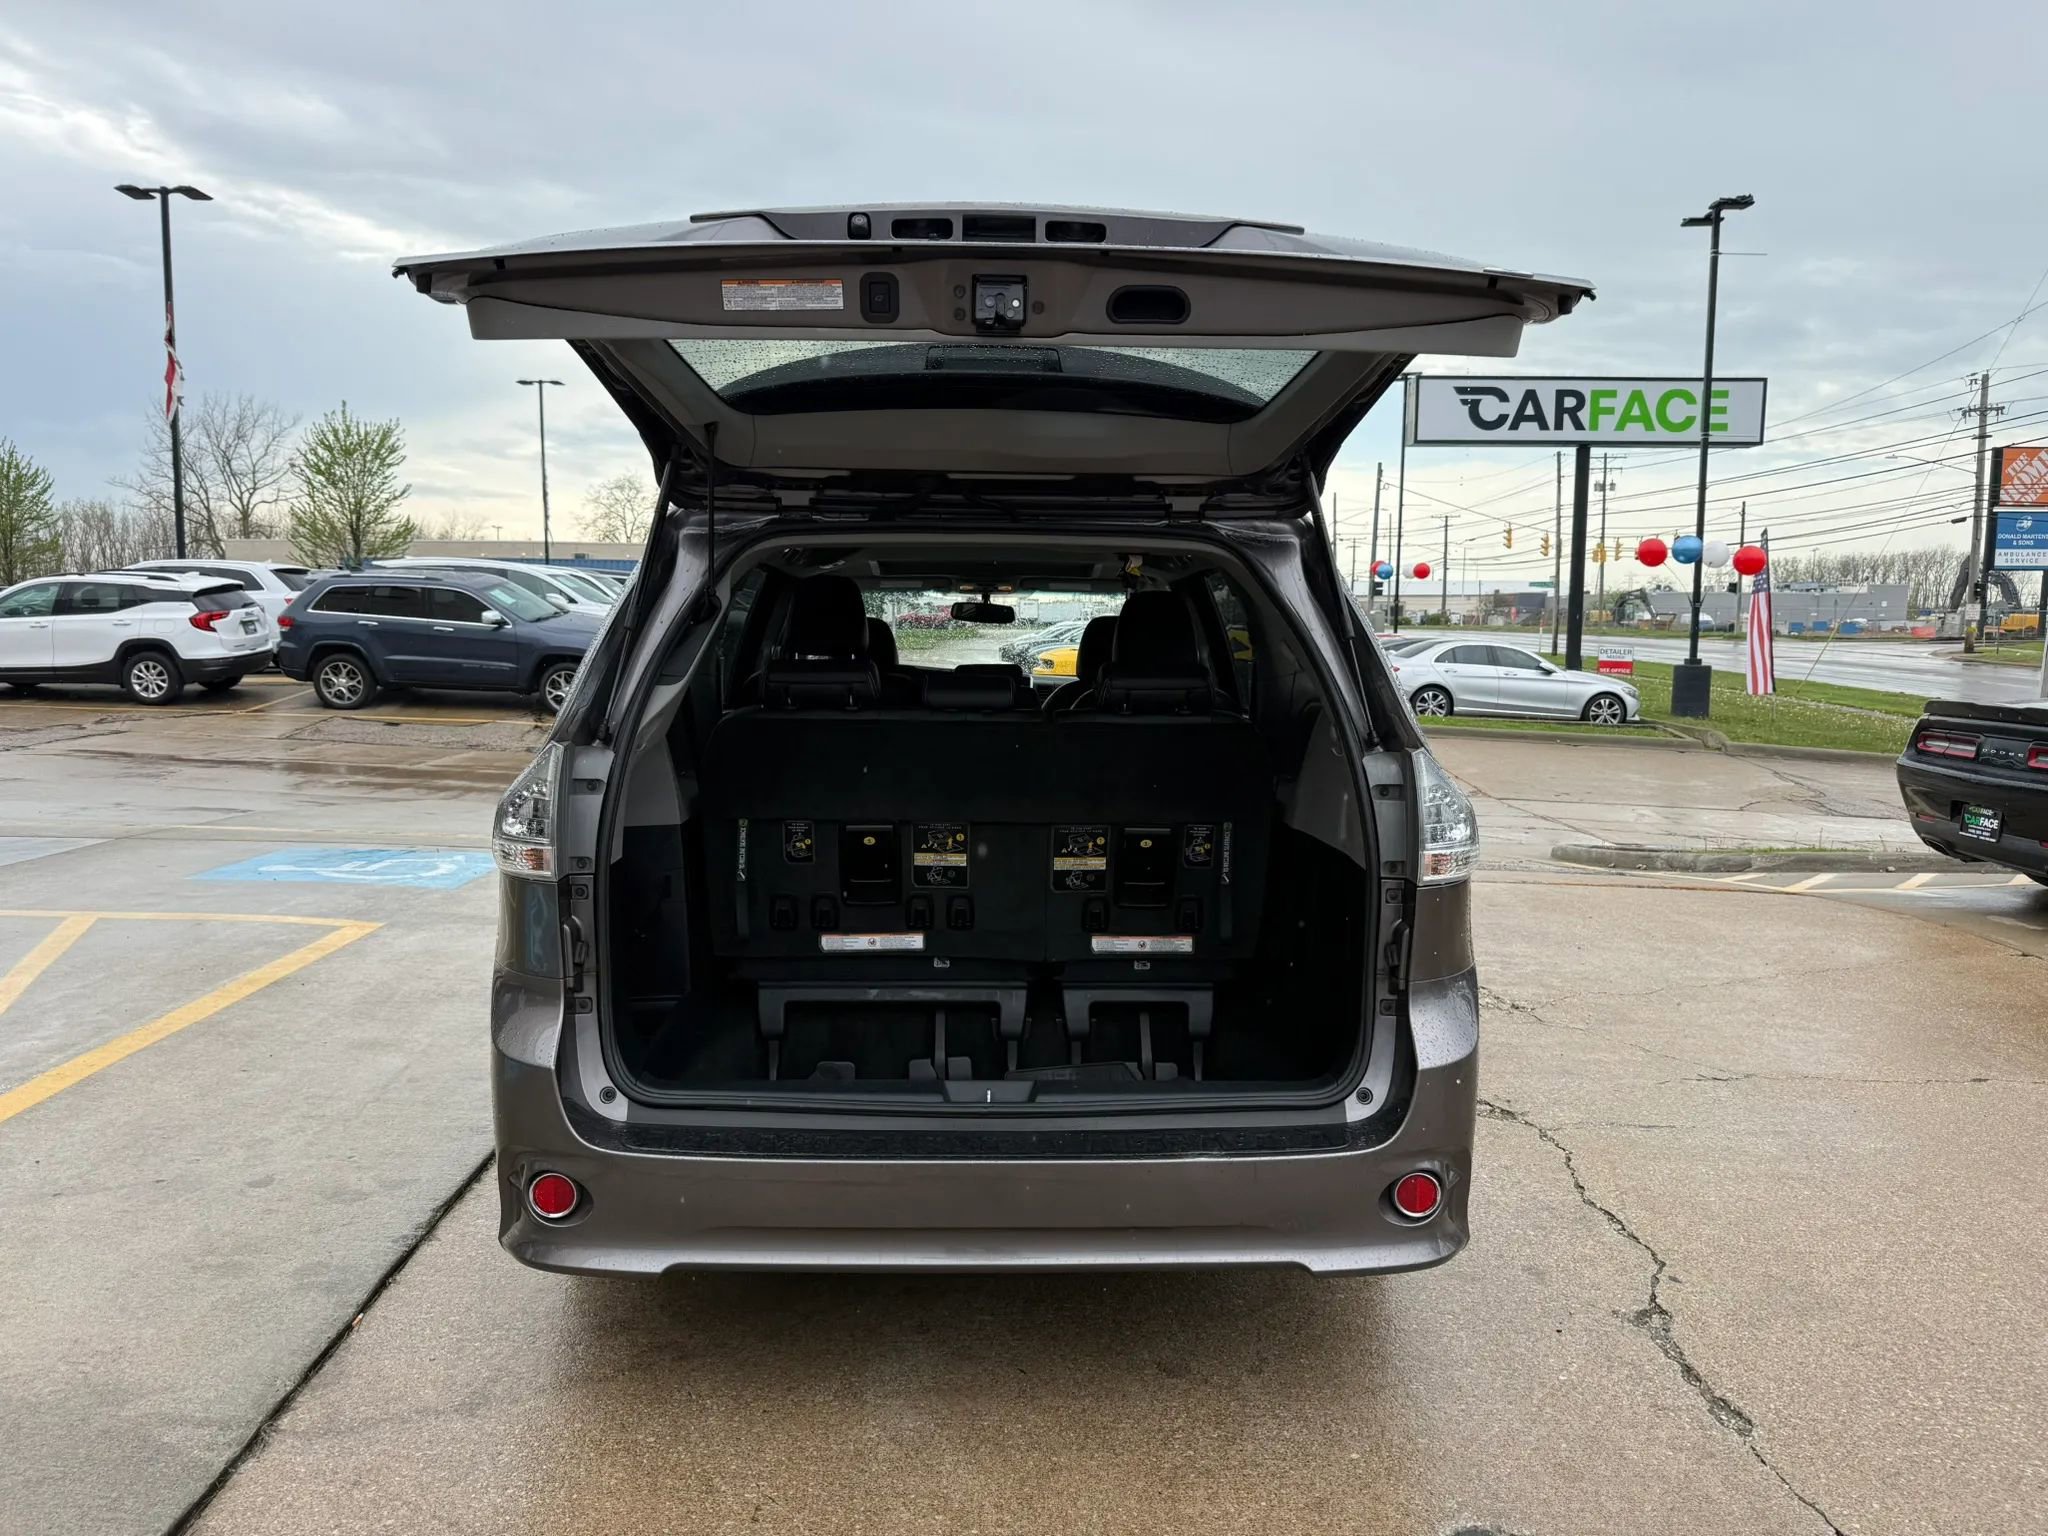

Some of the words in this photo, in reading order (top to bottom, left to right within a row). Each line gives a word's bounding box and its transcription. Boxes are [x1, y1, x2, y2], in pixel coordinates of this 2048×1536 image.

[1453, 386, 1730, 433] CARFACE
[2005, 452, 2031, 478] THE
[1964, 814, 1999, 829] CARFACE
